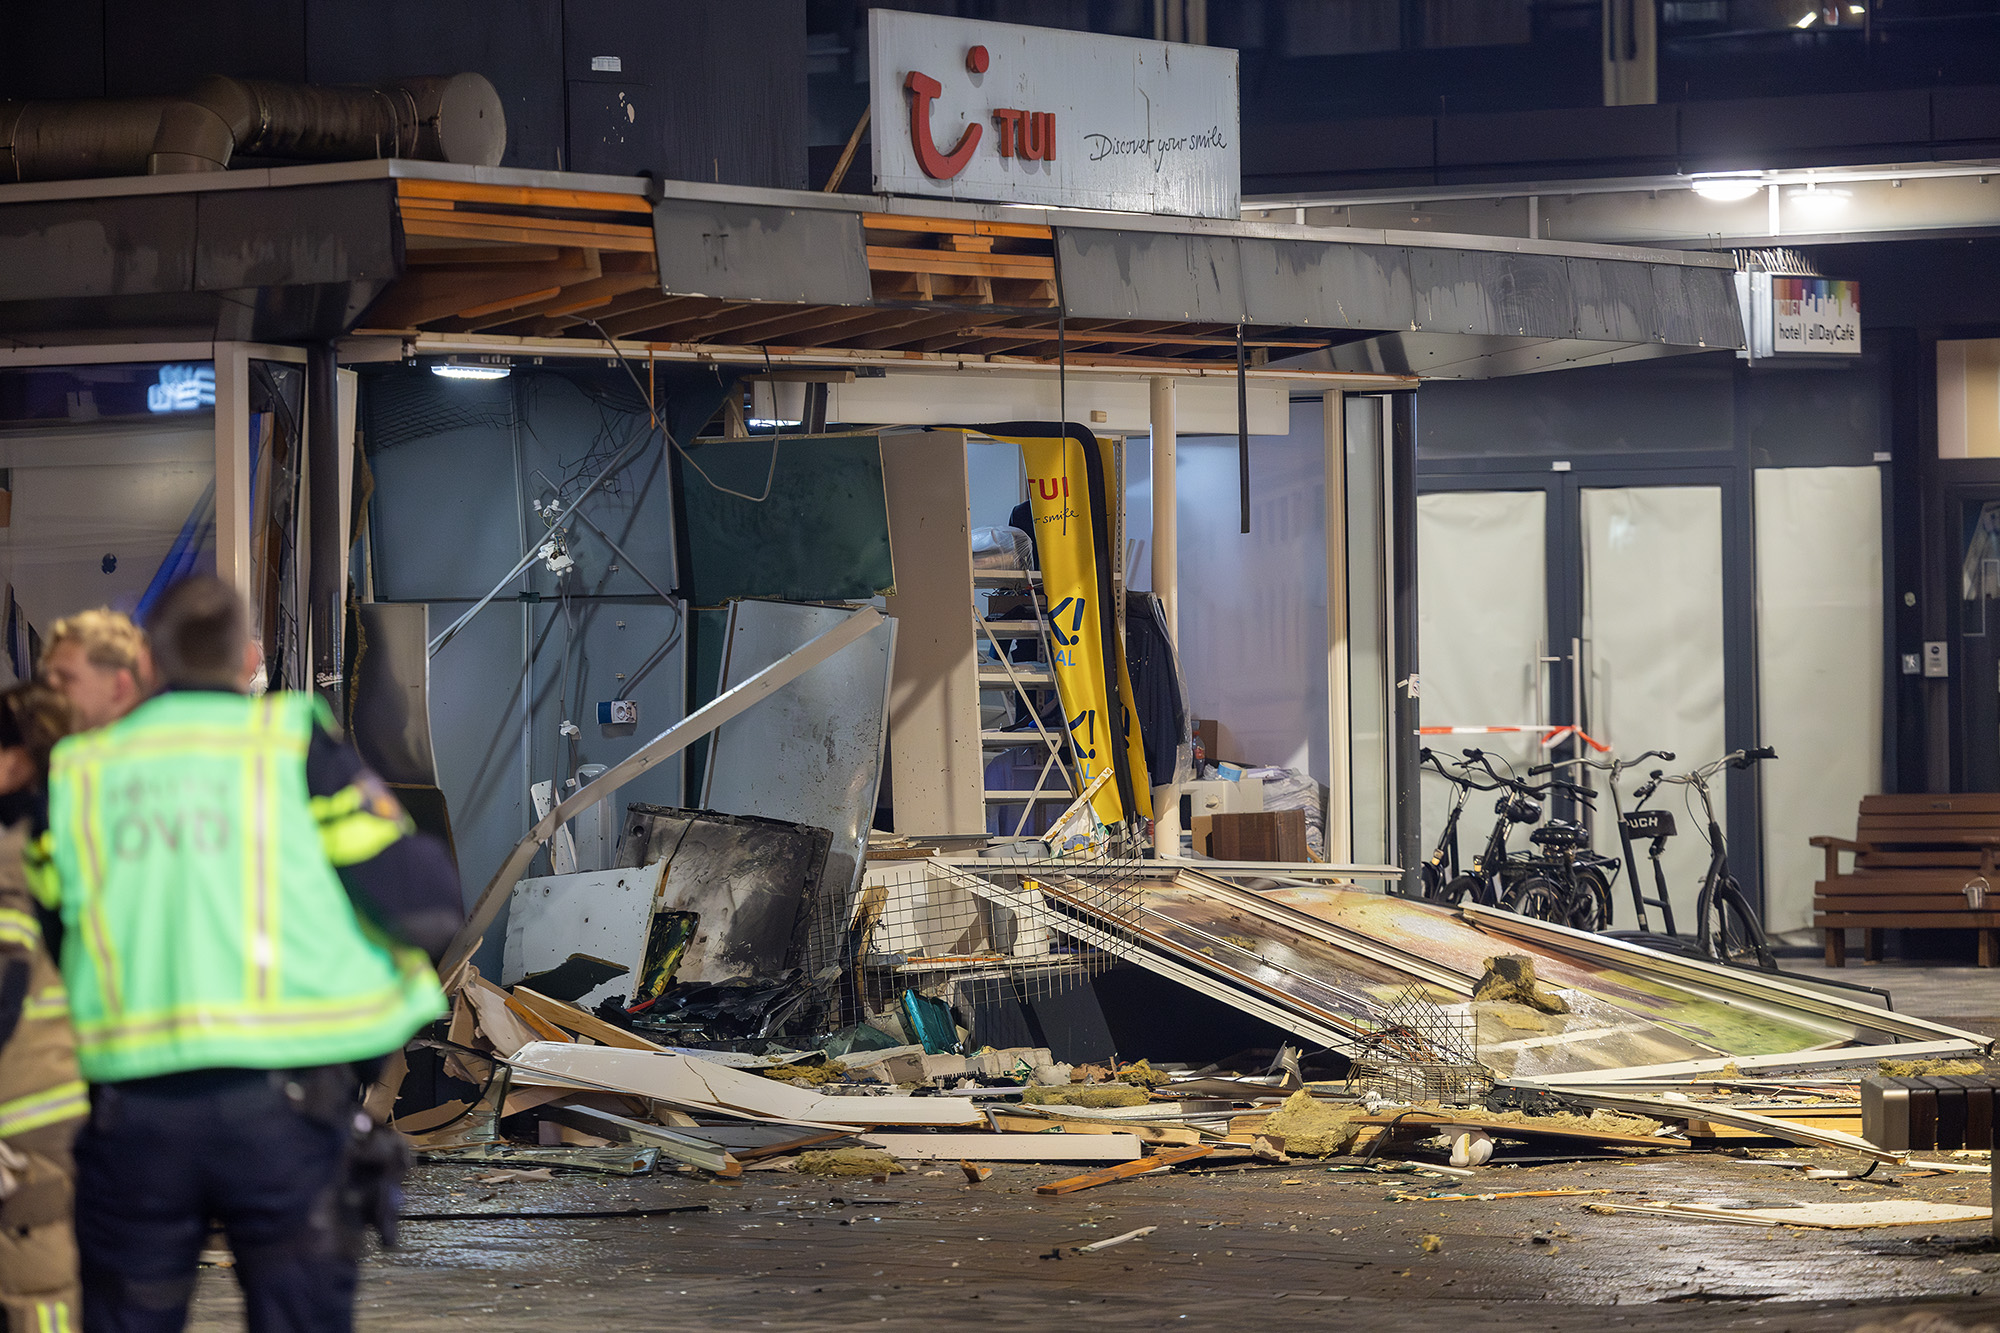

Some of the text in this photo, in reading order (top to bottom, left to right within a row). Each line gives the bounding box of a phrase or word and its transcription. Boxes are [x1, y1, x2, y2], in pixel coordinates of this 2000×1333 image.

[993, 108, 1056, 161] TUI
[1084, 125, 1227, 173] Discover your smile
[1779, 322, 1801, 339] hotel
[1043, 507, 1080, 524] smile
